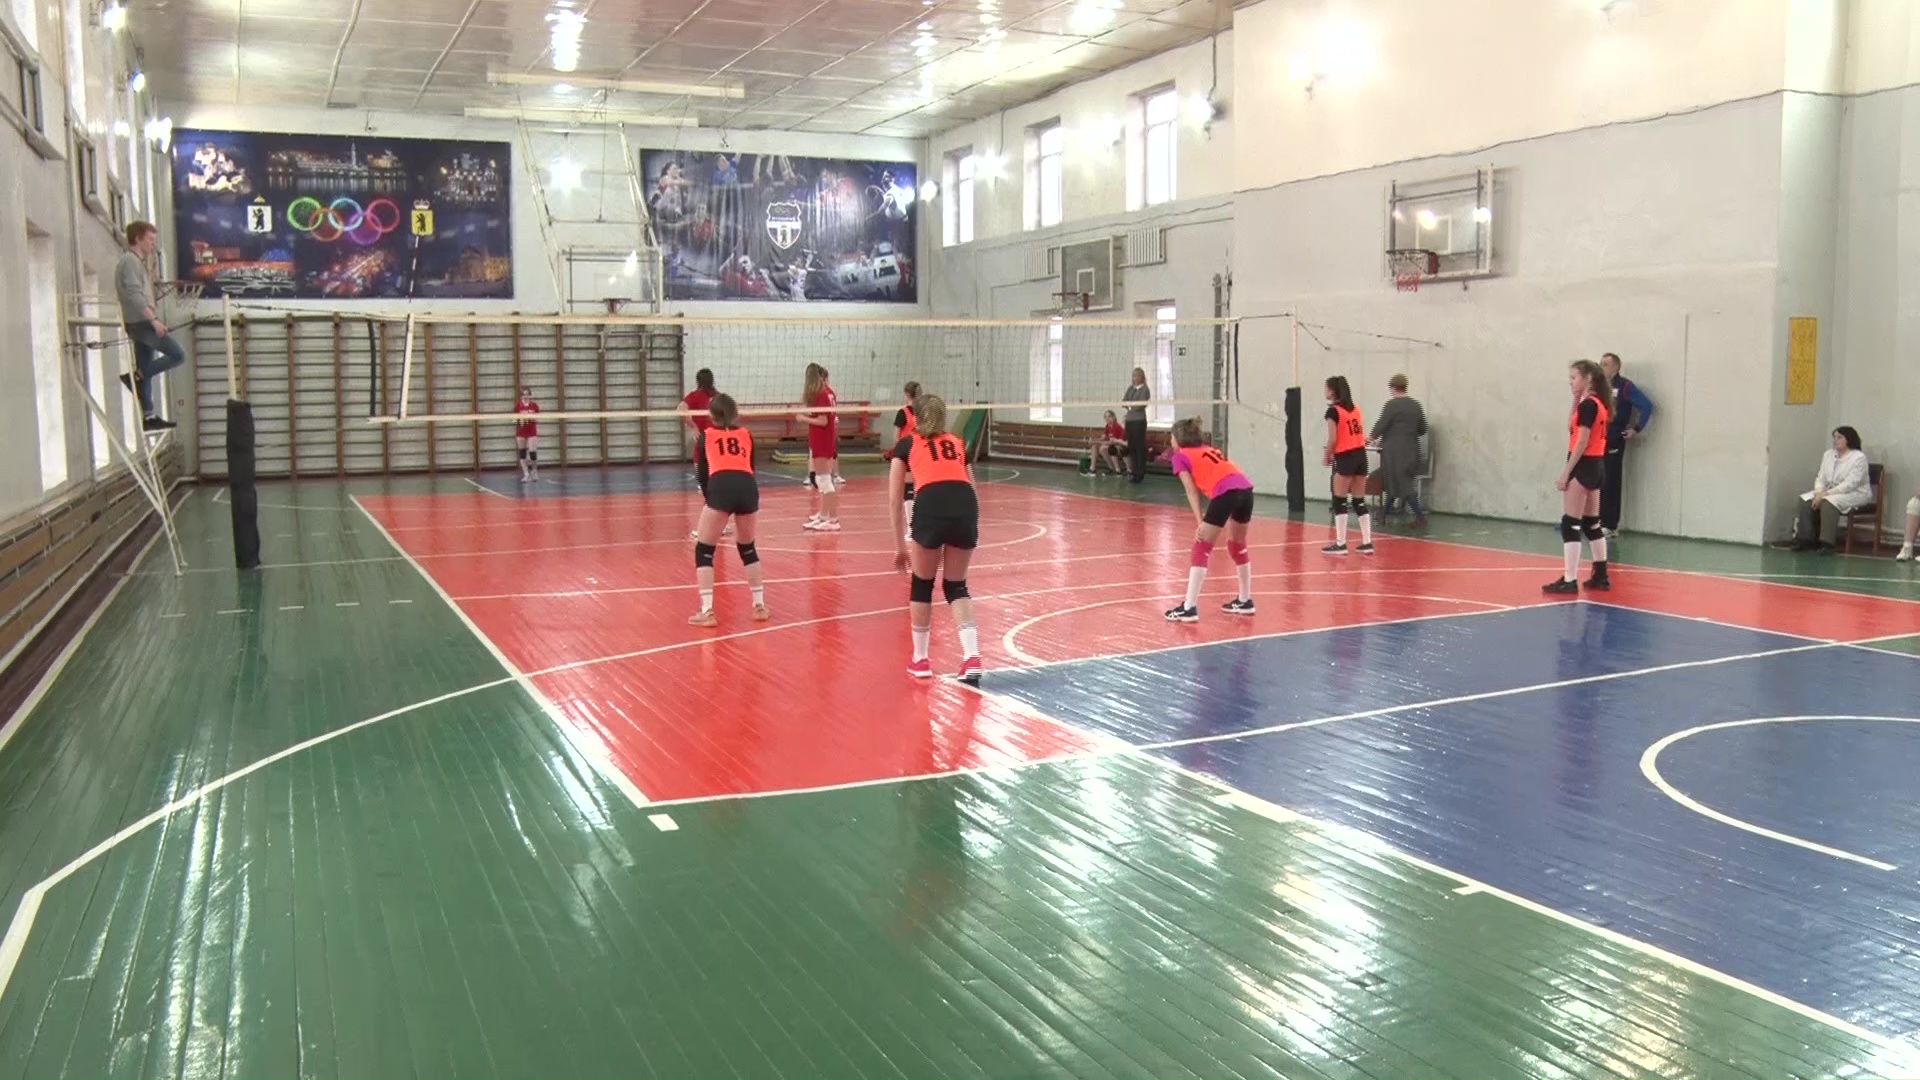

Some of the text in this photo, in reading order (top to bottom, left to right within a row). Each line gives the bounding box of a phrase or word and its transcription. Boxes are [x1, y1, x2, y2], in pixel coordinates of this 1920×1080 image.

[1346, 418, 1361, 436] 18
[714, 437, 740, 456] 18
[923, 439, 958, 461] 18
